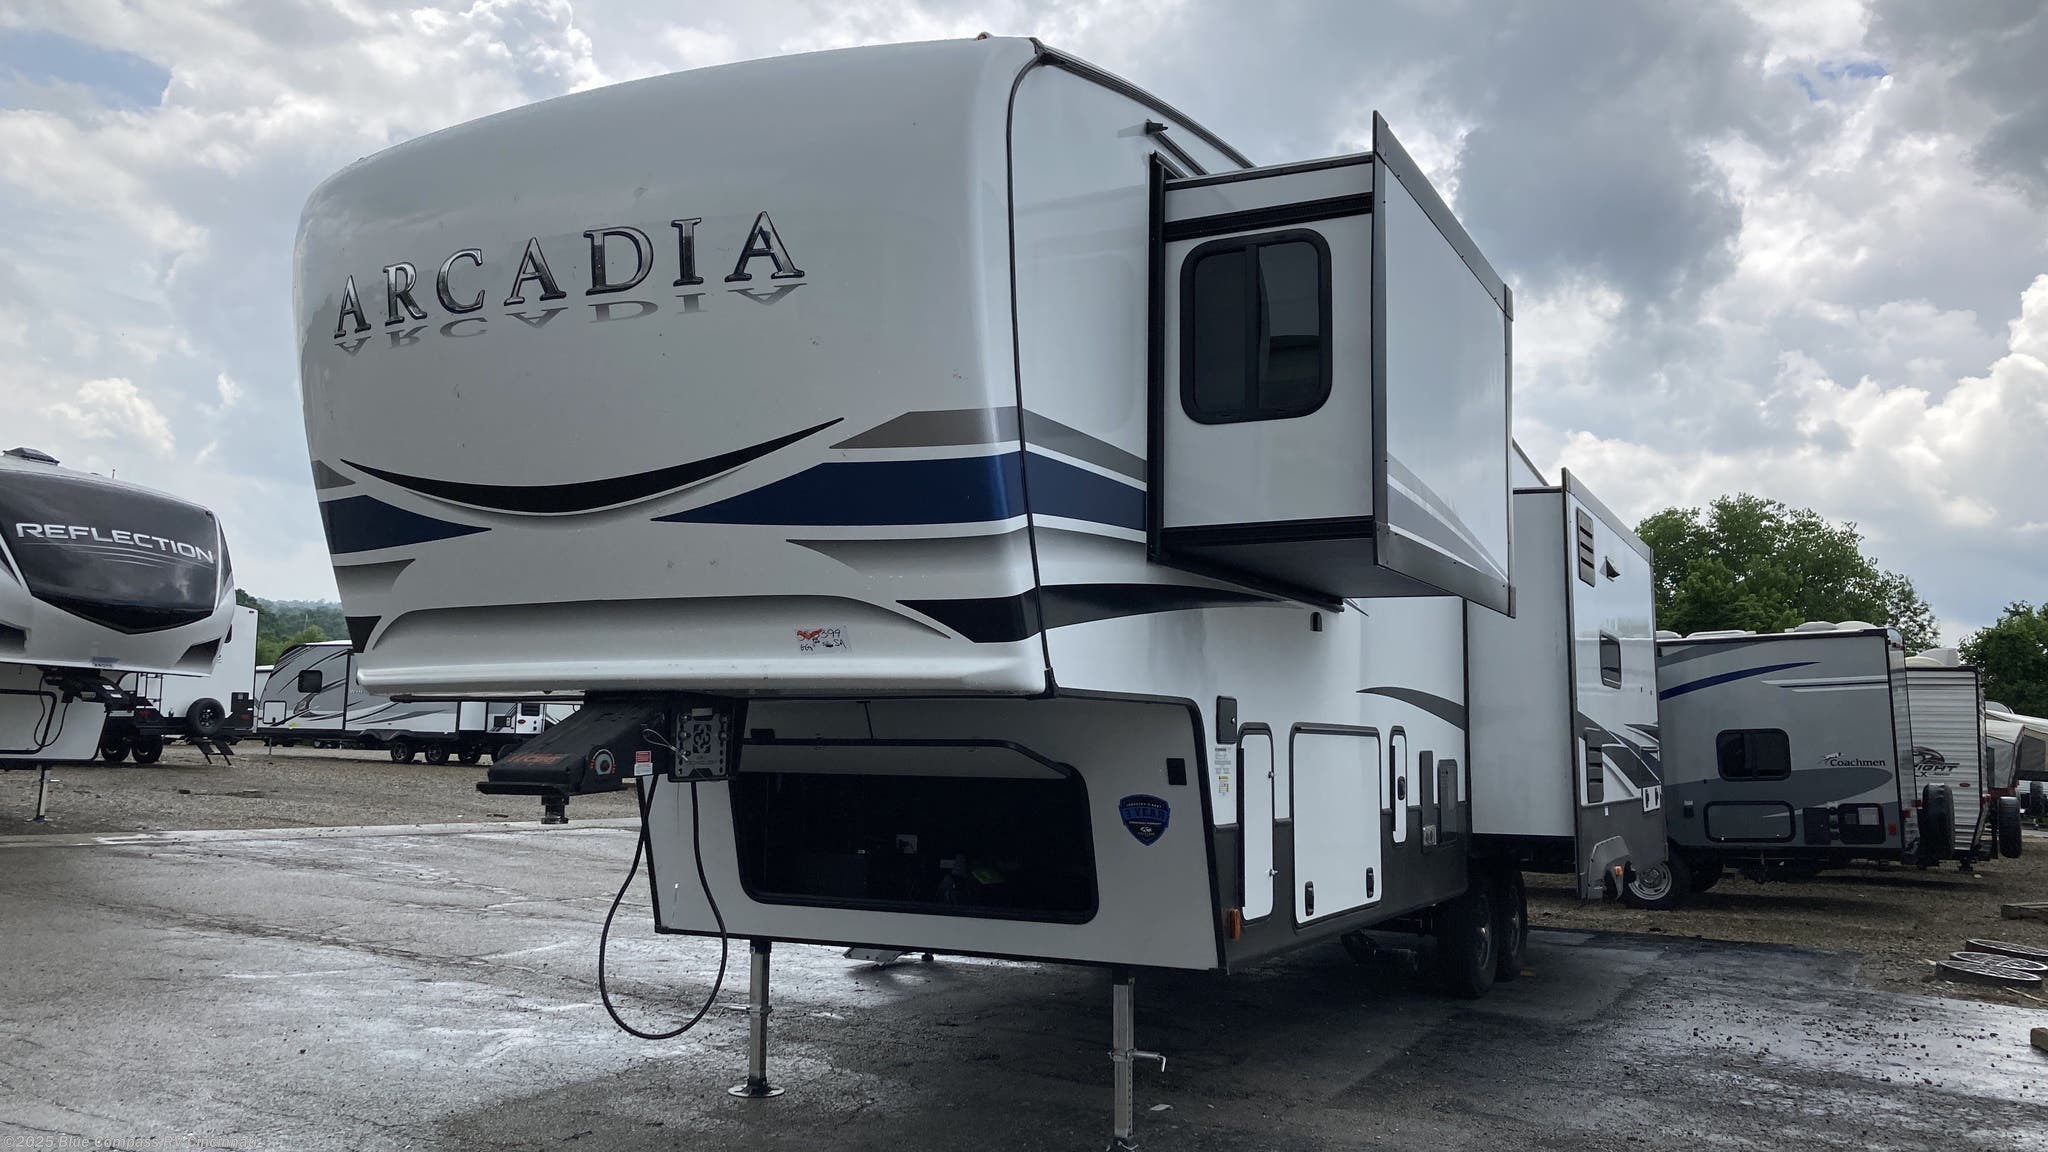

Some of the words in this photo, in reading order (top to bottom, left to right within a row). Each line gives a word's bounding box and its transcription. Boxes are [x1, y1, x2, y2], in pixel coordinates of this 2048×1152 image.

[333, 210, 805, 339] ARCADIA
[15, 522, 215, 564] REFLECTION
[1830, 758, 1886, 767] Coachmen
